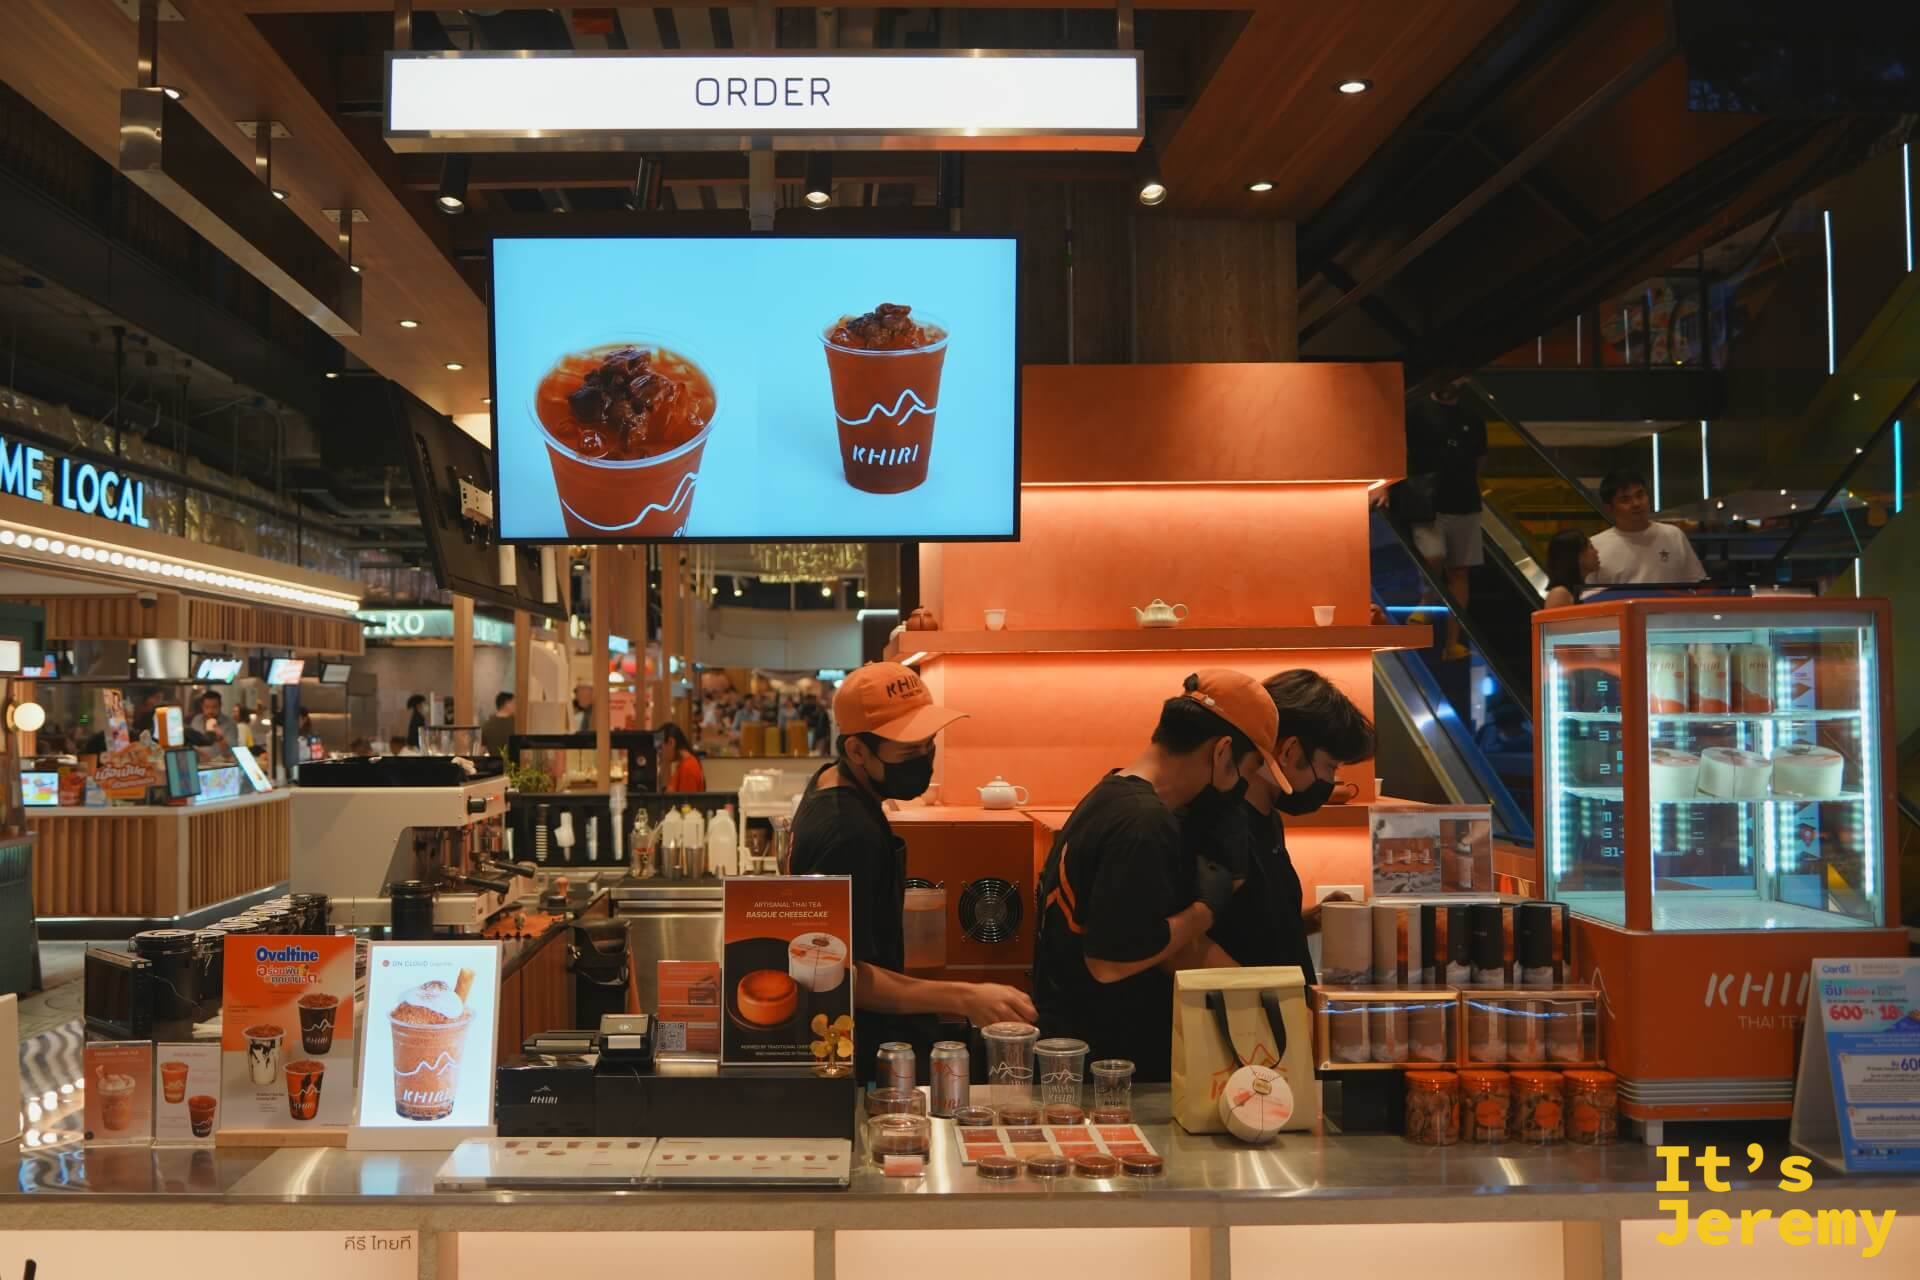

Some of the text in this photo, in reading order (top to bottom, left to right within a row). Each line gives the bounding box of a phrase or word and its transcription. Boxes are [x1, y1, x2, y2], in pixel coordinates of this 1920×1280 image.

[696, 77, 830, 106] ORDER
[852, 444, 919, 465] KHIRI
[62, 458, 150, 528] LOCAL
[754, 901, 822, 909] ARTISANAL THAI TEA
[256, 945, 319, 962] Ovaltine
[1829, 1003, 1864, 1021] 600
[1737, 1015, 1775, 1030] THAI
[530, 1095, 558, 1105] KHIRI
